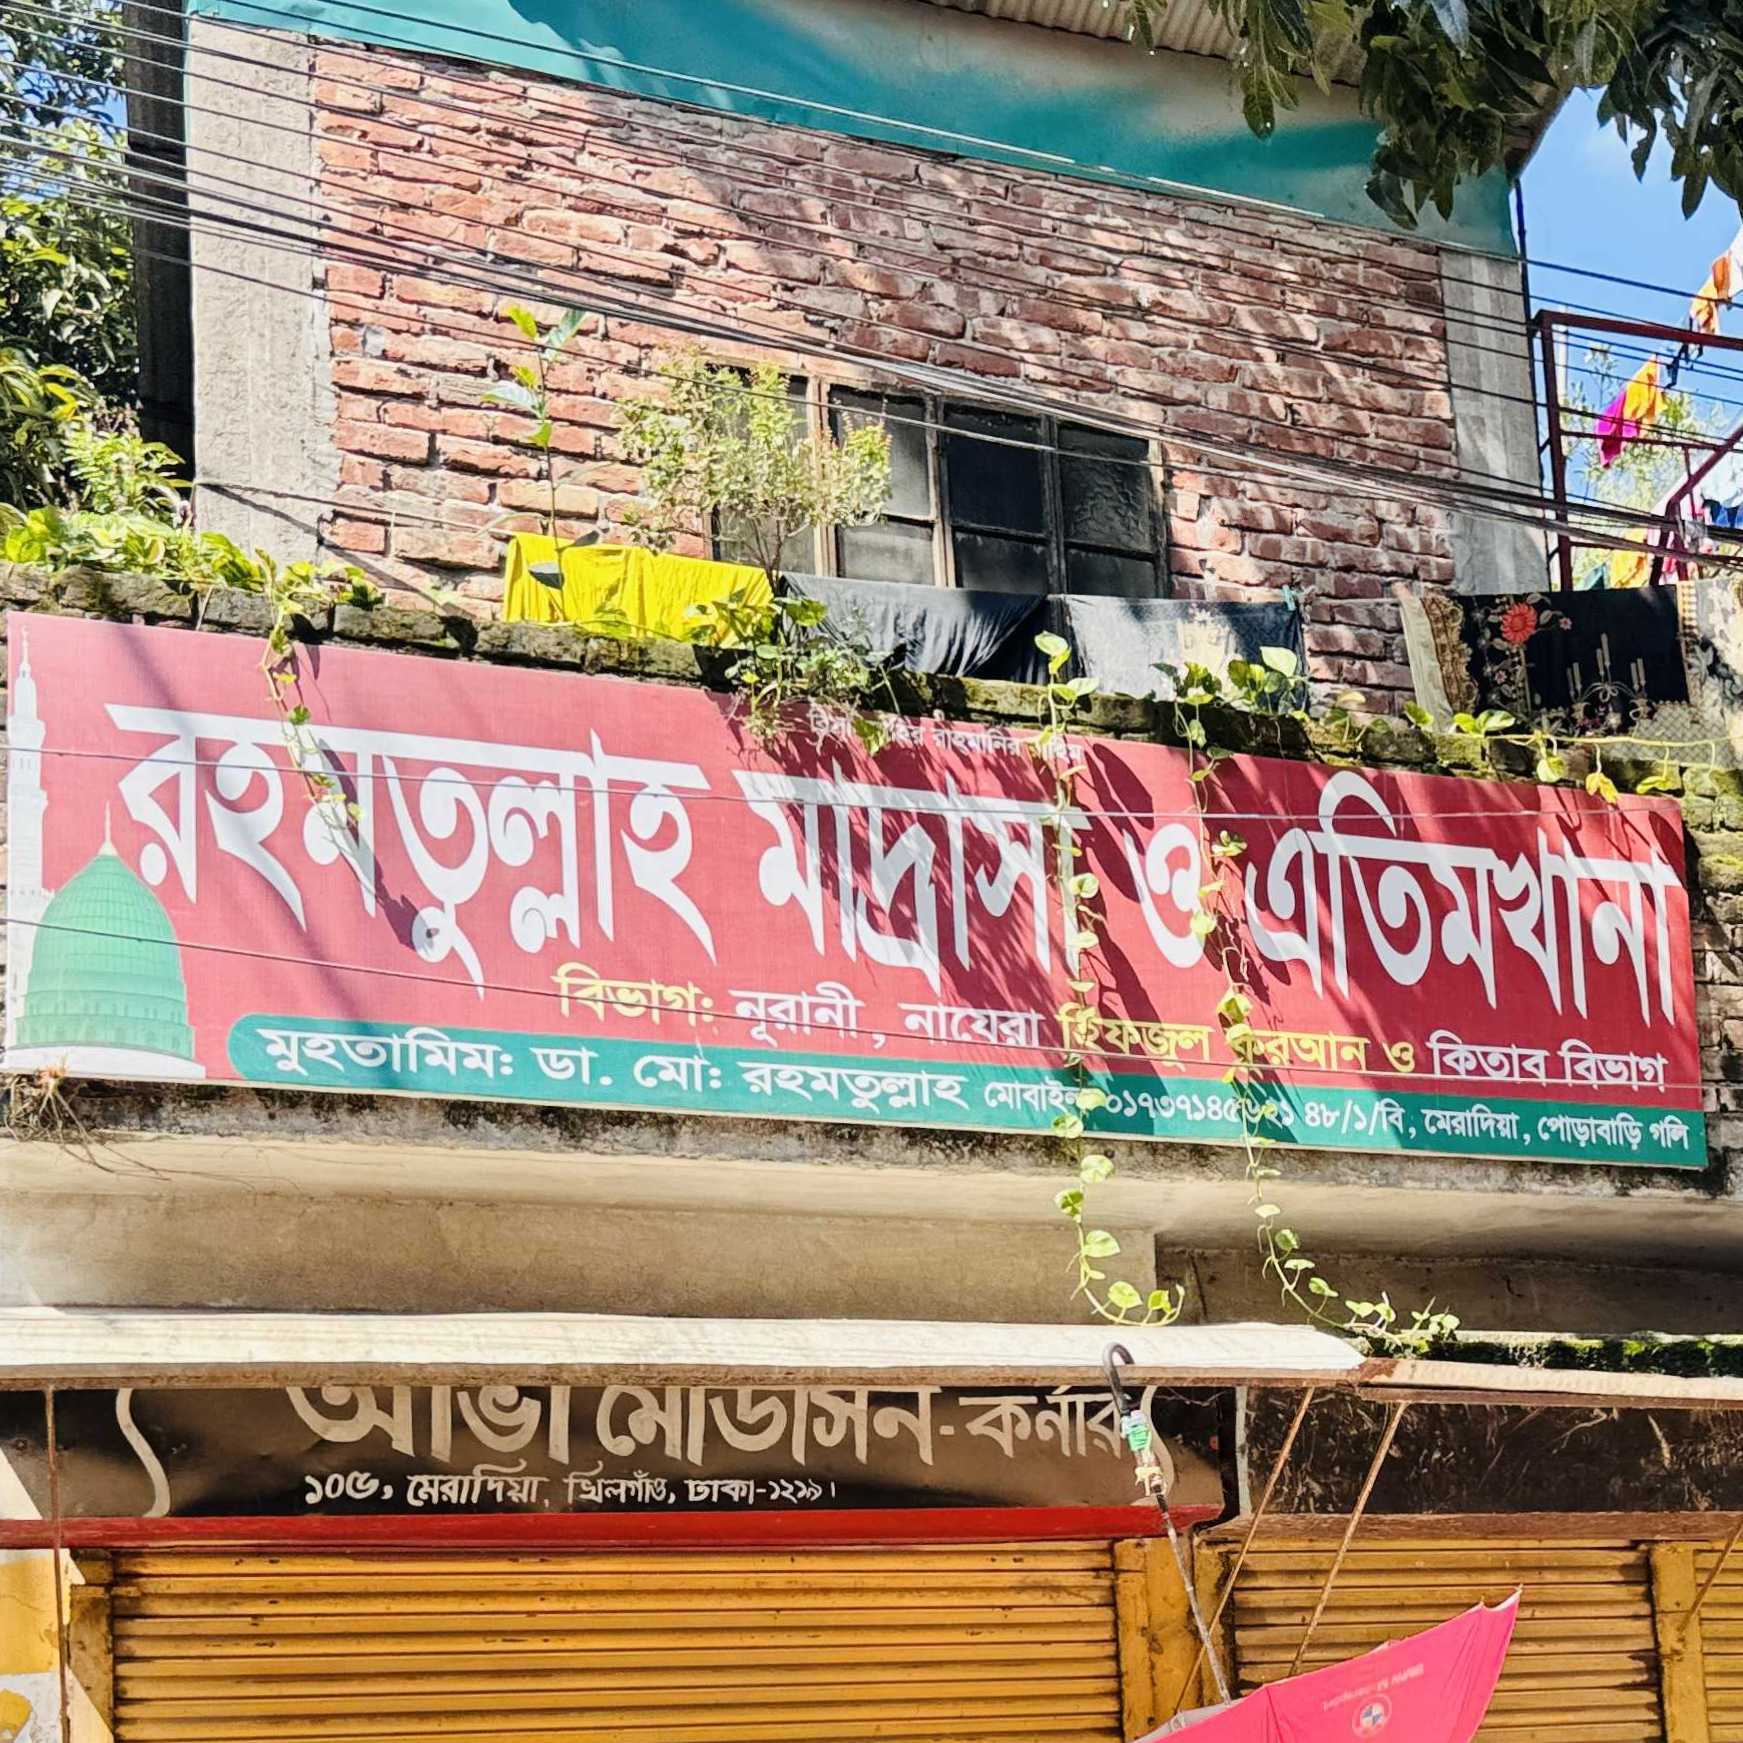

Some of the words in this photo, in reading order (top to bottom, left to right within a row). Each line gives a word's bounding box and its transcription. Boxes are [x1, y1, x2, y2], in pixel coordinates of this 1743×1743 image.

[105, 702, 718, 1000] রহমতুল্লাহ
[733, 758, 1093, 997] মাদ্রাসা
[1122, 823, 1207, 969] ও
[1246, 770, 1684, 1027] এতিমখানা
[1382, 1041, 1416, 1073] ও
[1426, 1029, 1550, 1086] কিতাব
[1557, 1038, 1669, 1092] বিভাগ
[738, 1062, 969, 1113] রহমতুল্লাহ
[1537, 1113, 1643, 1151] পোড়াবাড়ি
[1649, 1121, 1690, 1151] গলি
